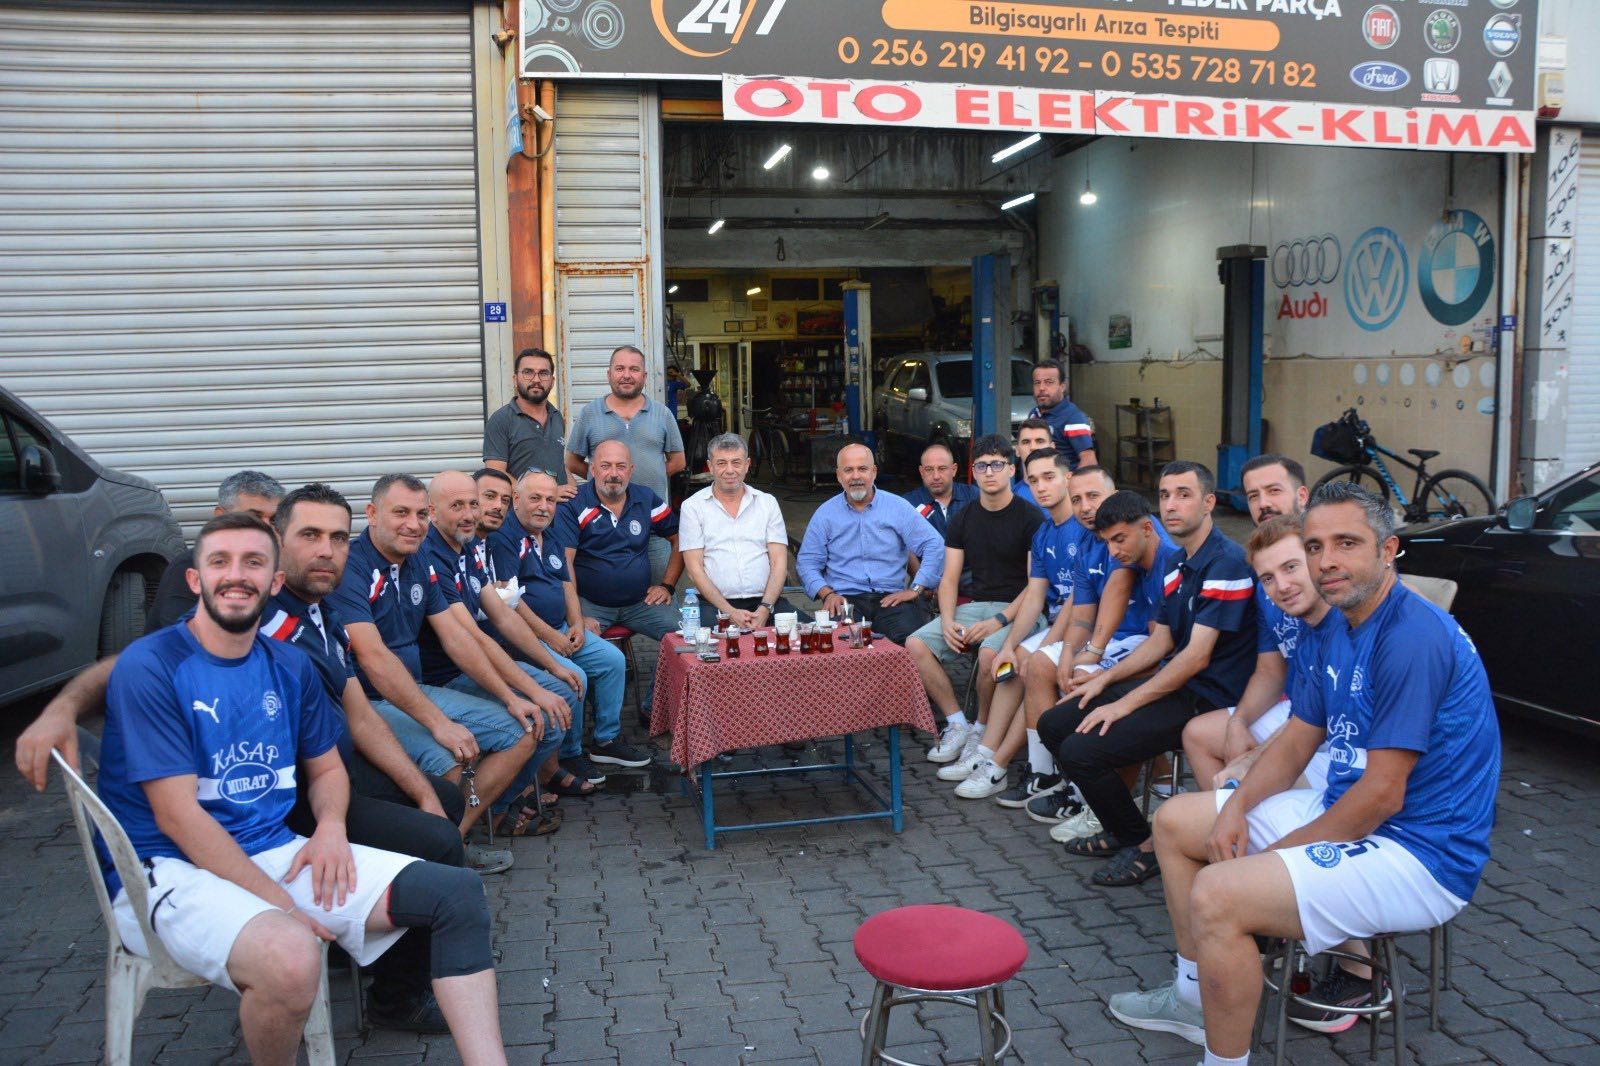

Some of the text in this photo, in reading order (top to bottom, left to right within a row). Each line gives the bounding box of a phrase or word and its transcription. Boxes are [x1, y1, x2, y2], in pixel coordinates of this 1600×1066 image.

[969, 5, 1219, 43] Bilgisayarlı Arıza Tespiti
[1371, 18, 1392, 37] FIAT
[838, 37, 860, 64] 0
[871, 38, 928, 66] 256
[938, 41, 986, 69] 219
[996, 44, 1026, 72] 41
[1035, 46, 1069, 74] 92
[1101, 50, 1121, 77] 0
[1130, 52, 1182, 80] 535
[1190, 56, 1241, 84] 728
[1249, 59, 1275, 85] 71
[1283, 61, 1317, 88] 82
[1363, 66, 1397, 86] Ford
[734, 79, 922, 122] OTO
[490, 305, 501, 315] 29
[1277, 291, 1328, 320] Audi
[211, 741, 279, 775] KASAP
[226, 774, 269, 795] MURAT
